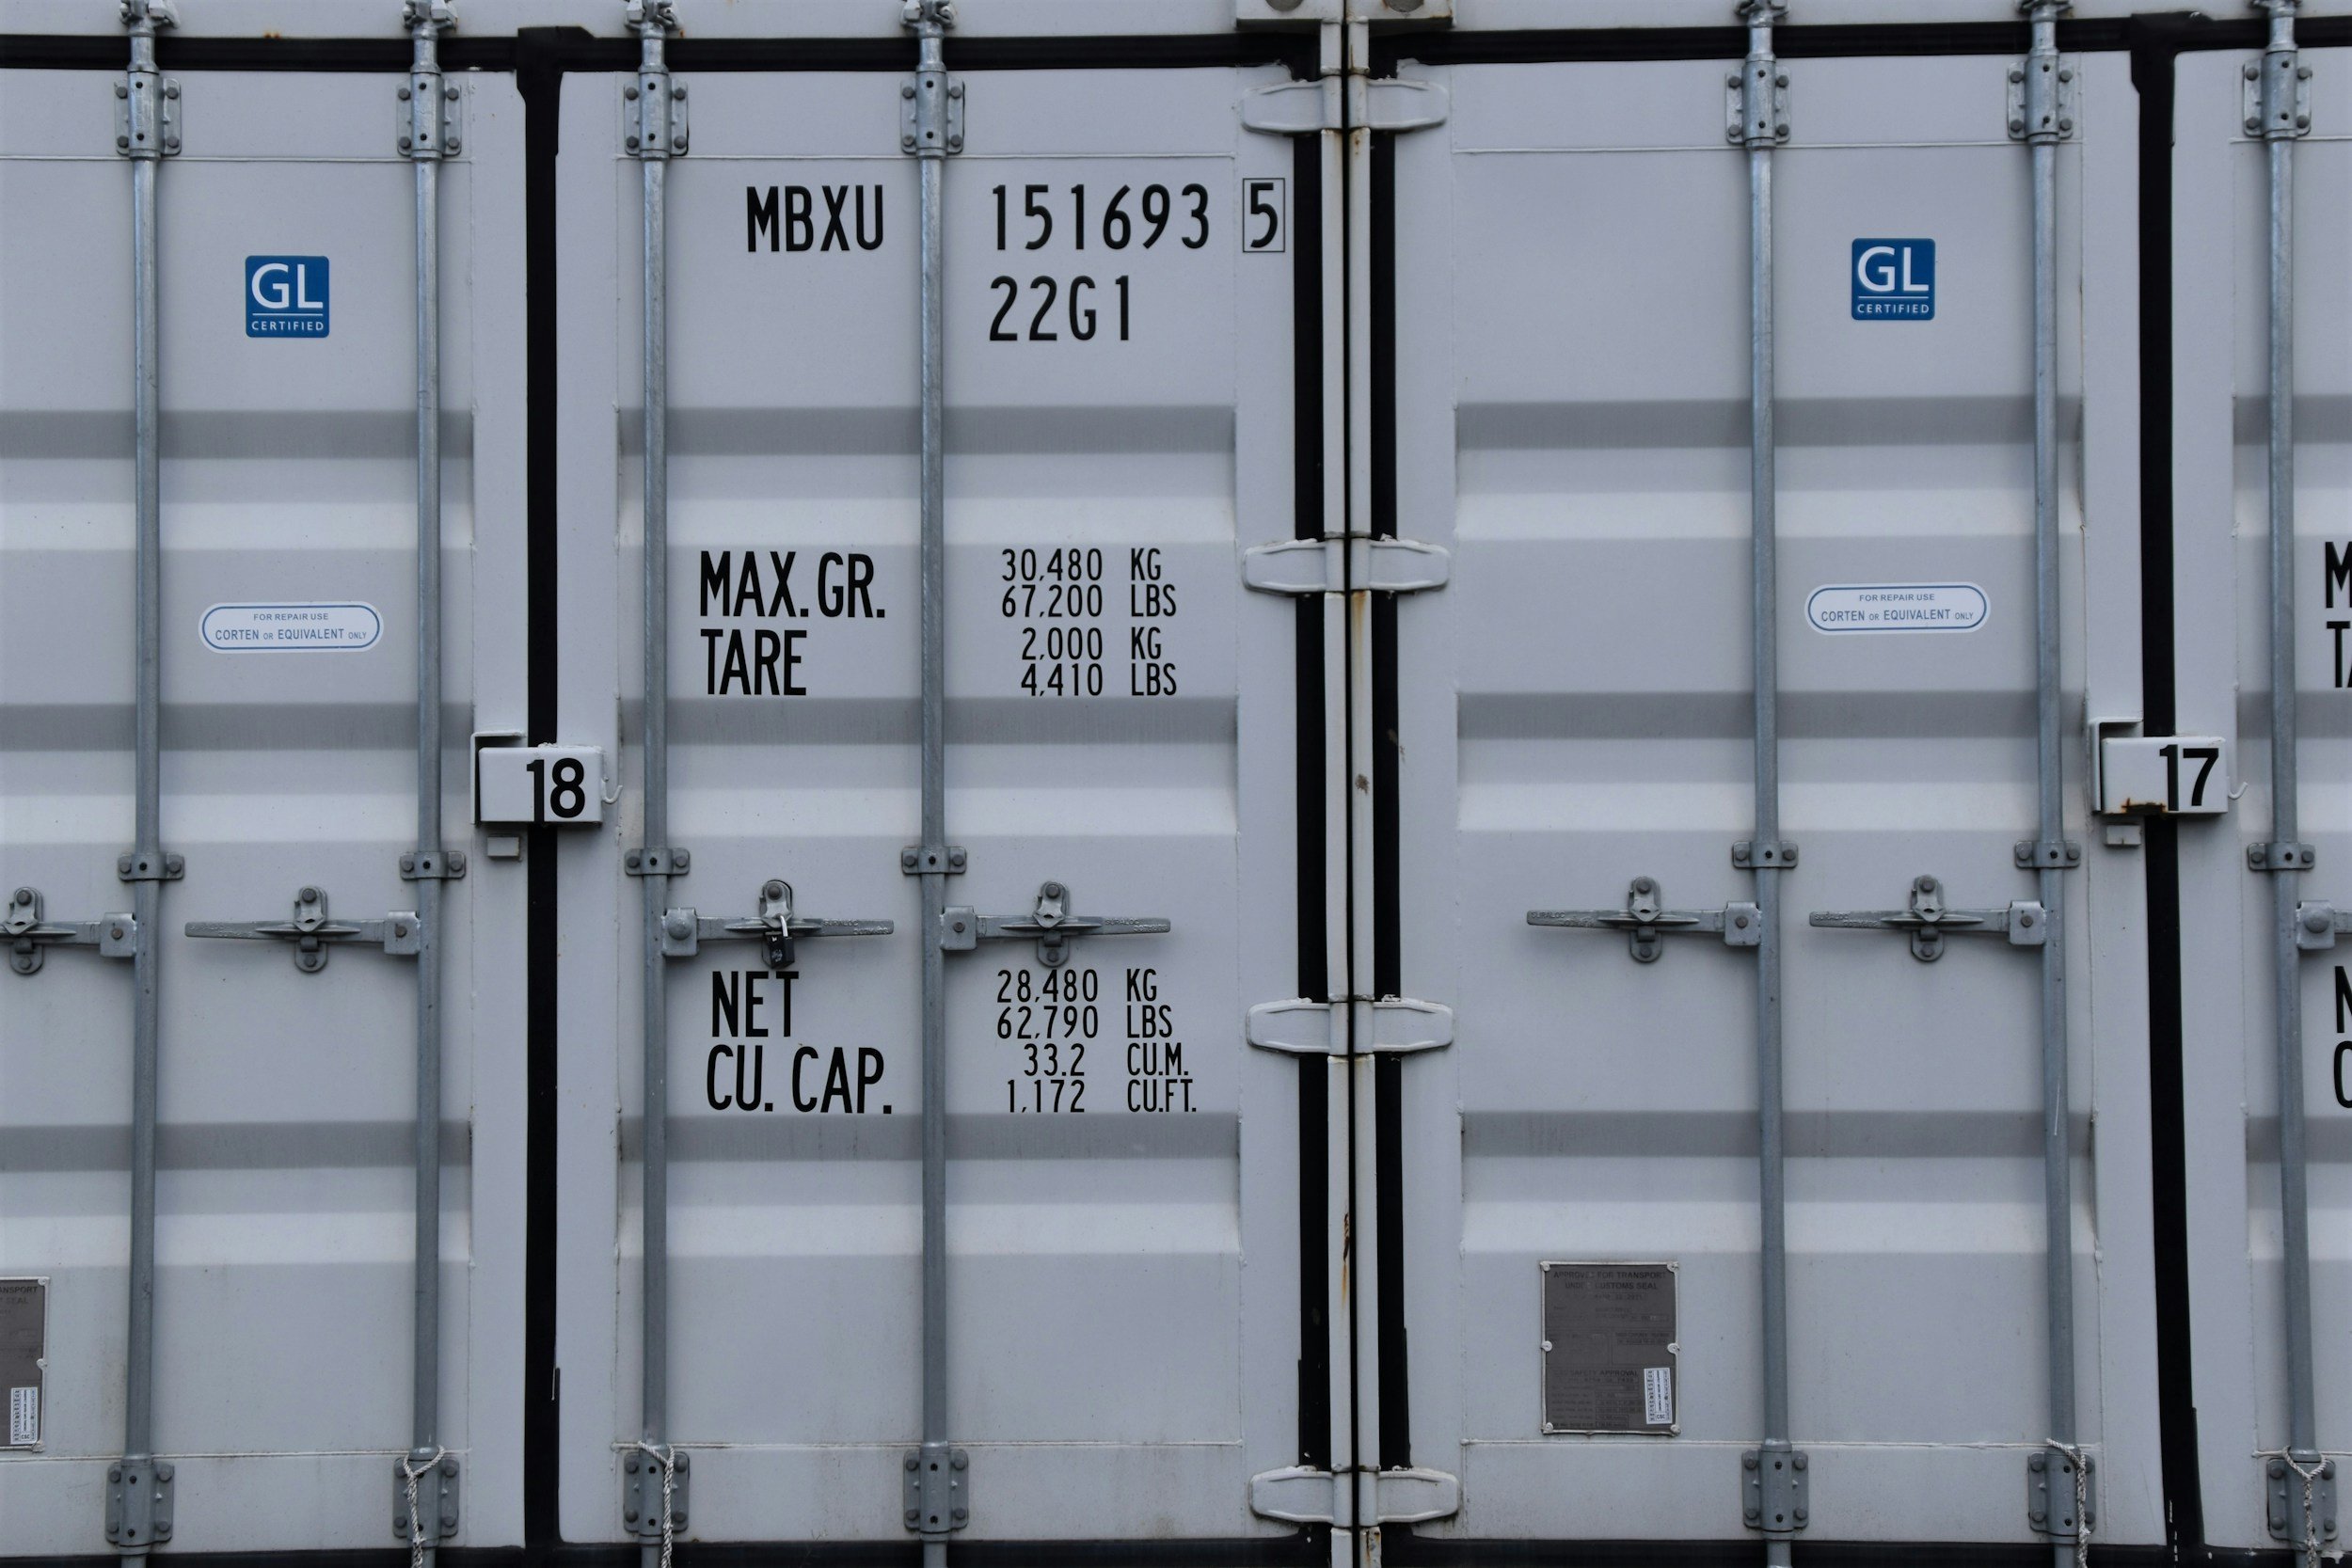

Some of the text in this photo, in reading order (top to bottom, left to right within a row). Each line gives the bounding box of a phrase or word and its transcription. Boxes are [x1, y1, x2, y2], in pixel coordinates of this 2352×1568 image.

[747, 182, 1278, 252] MBXU 151693 5
[251, 262, 324, 309] GL
[1858, 245, 1930, 292] GL
[990, 276, 1128, 341] 22G1
[1857, 303, 1930, 313] CERTIFIED
[251, 321, 325, 331] CERTIFIED
[1002, 548, 1161, 582] 30,480 KG
[1003, 584, 1176, 617] 67,200 LBS
[1821, 610, 1865, 622] CORTEN
[1883, 609, 1951, 621] EQUIVALENT
[215, 629, 259, 641] CORTEN
[278, 628, 344, 640] EQUIVALENT
[1022, 627, 1161, 661] 2,000 KG
[701, 629, 806, 695] TARE
[2327, 621, 2352, 688] T
[1022, 663, 1176, 696] 4,410 LBS
[526, 758, 586, 822] 18
[2159, 744, 2219, 812] 17
[997, 969, 1156, 1004] 28,480 KG
[712, 971, 800, 1037] NET
[997, 1005, 1172, 1038] 62,790 LBS
[1025, 1042, 1188, 1076] 33.2 CU.M.
[707, 1045, 892, 1114] CU. CAP.
[1008, 1079, 1196, 1113] 1,172 CU.FT.
[1617, 1271, 1666, 1279] TRANSPORT
